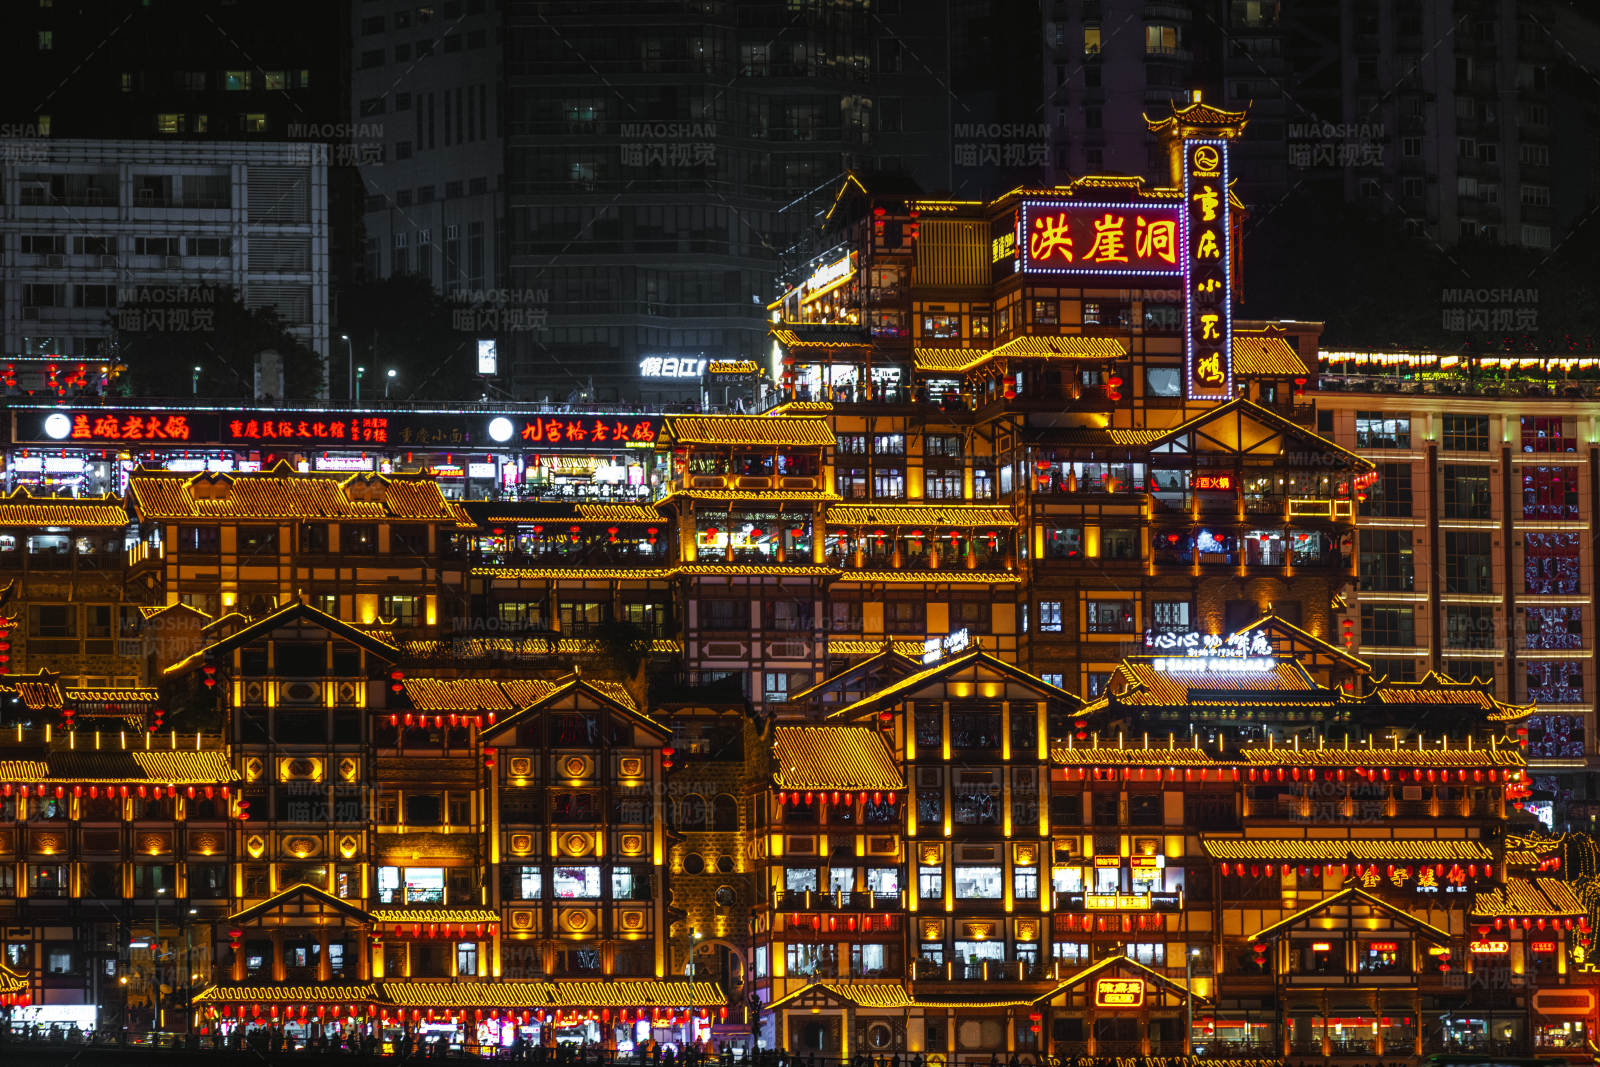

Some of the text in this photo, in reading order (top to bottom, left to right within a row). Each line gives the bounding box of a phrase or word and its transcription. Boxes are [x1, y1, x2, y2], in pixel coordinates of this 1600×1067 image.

[1030, 212, 1177, 264] 洪崖洞
[71, 413, 190, 440] 盖碗老火锅
[521, 416, 655, 442] 九宫格老火锅
